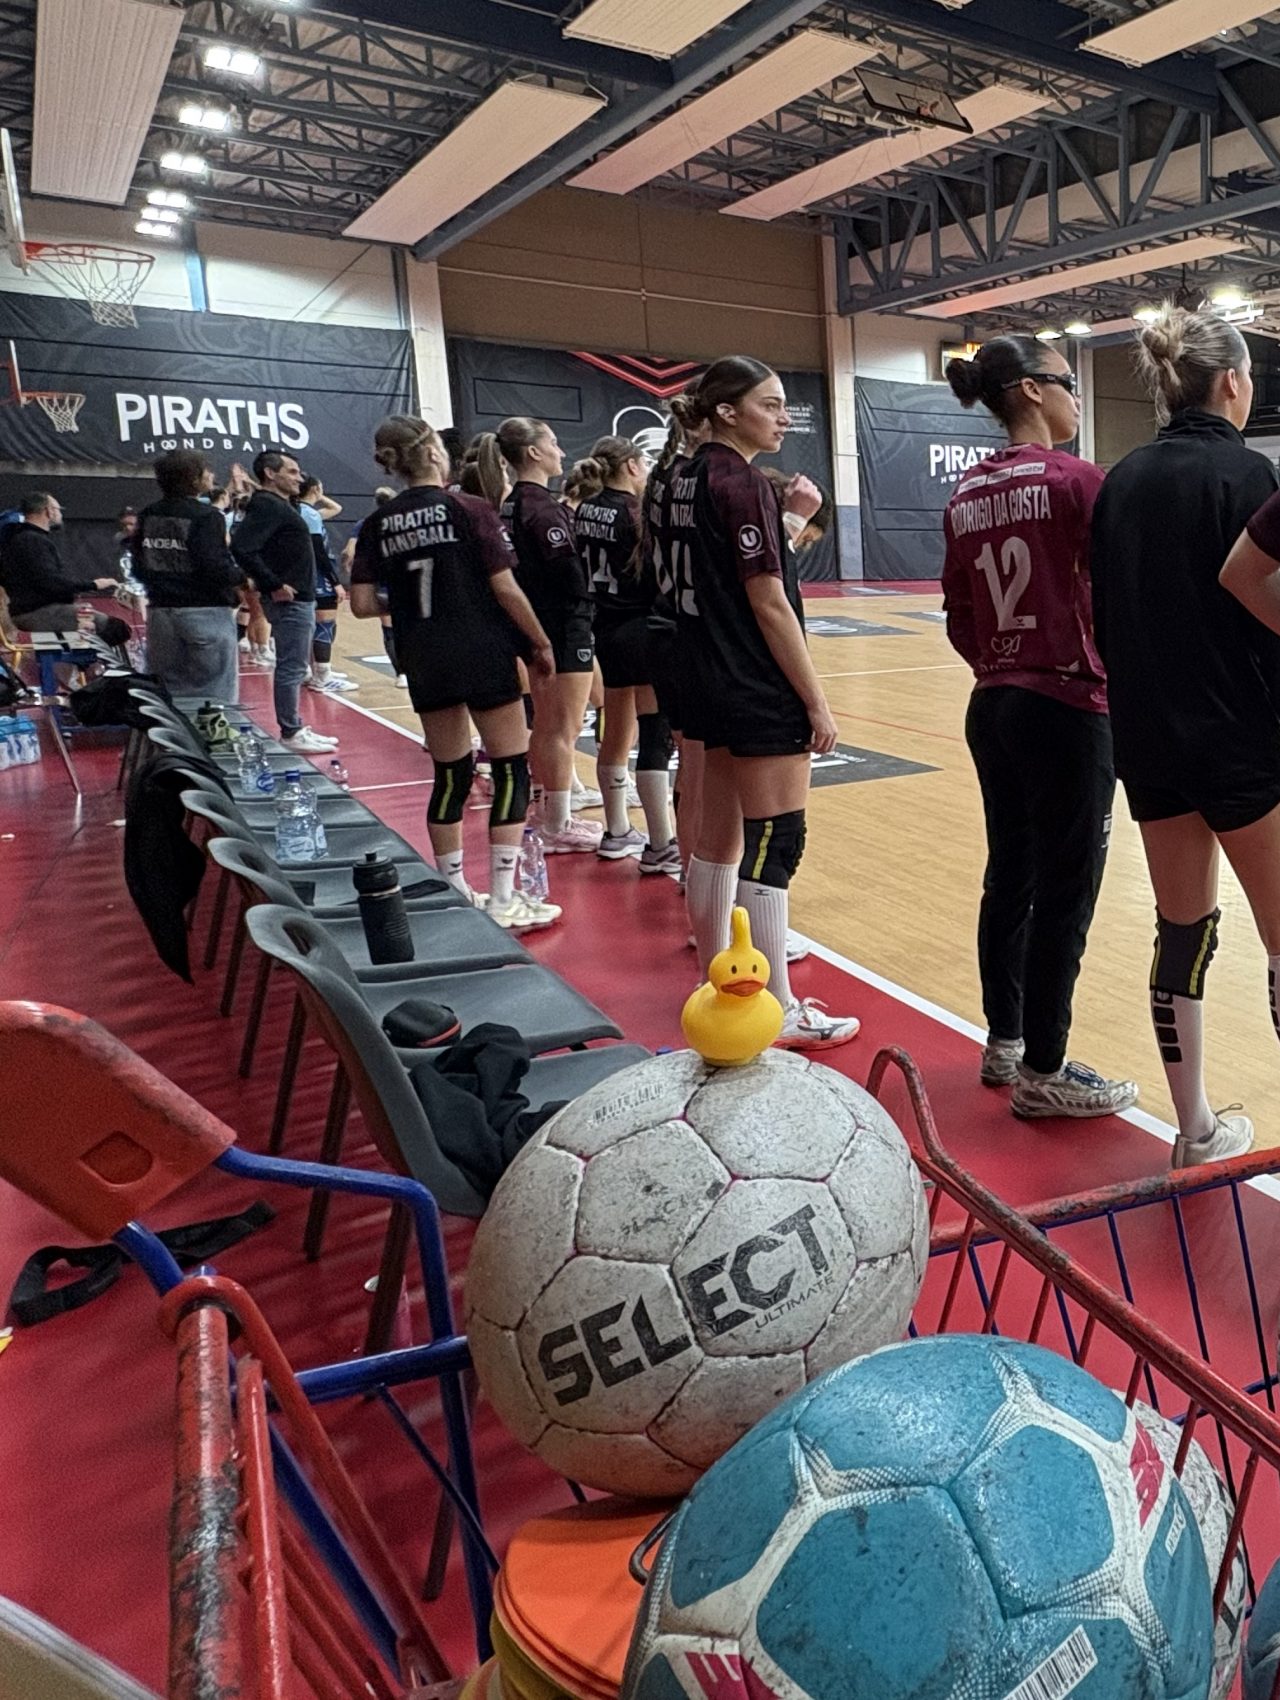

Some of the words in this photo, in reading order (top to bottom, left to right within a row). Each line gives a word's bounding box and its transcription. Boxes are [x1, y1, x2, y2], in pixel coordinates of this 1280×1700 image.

[115, 392, 310, 450] PIRATHS
[993, 491, 1010, 527] DA
[1008, 485, 1052, 523] COSTA
[407, 557, 434, 619] 7
[973, 536, 1037, 632] 12
[537, 1203, 829, 1407] SELECT
[755, 1270, 834, 1329] ULTIMATE
